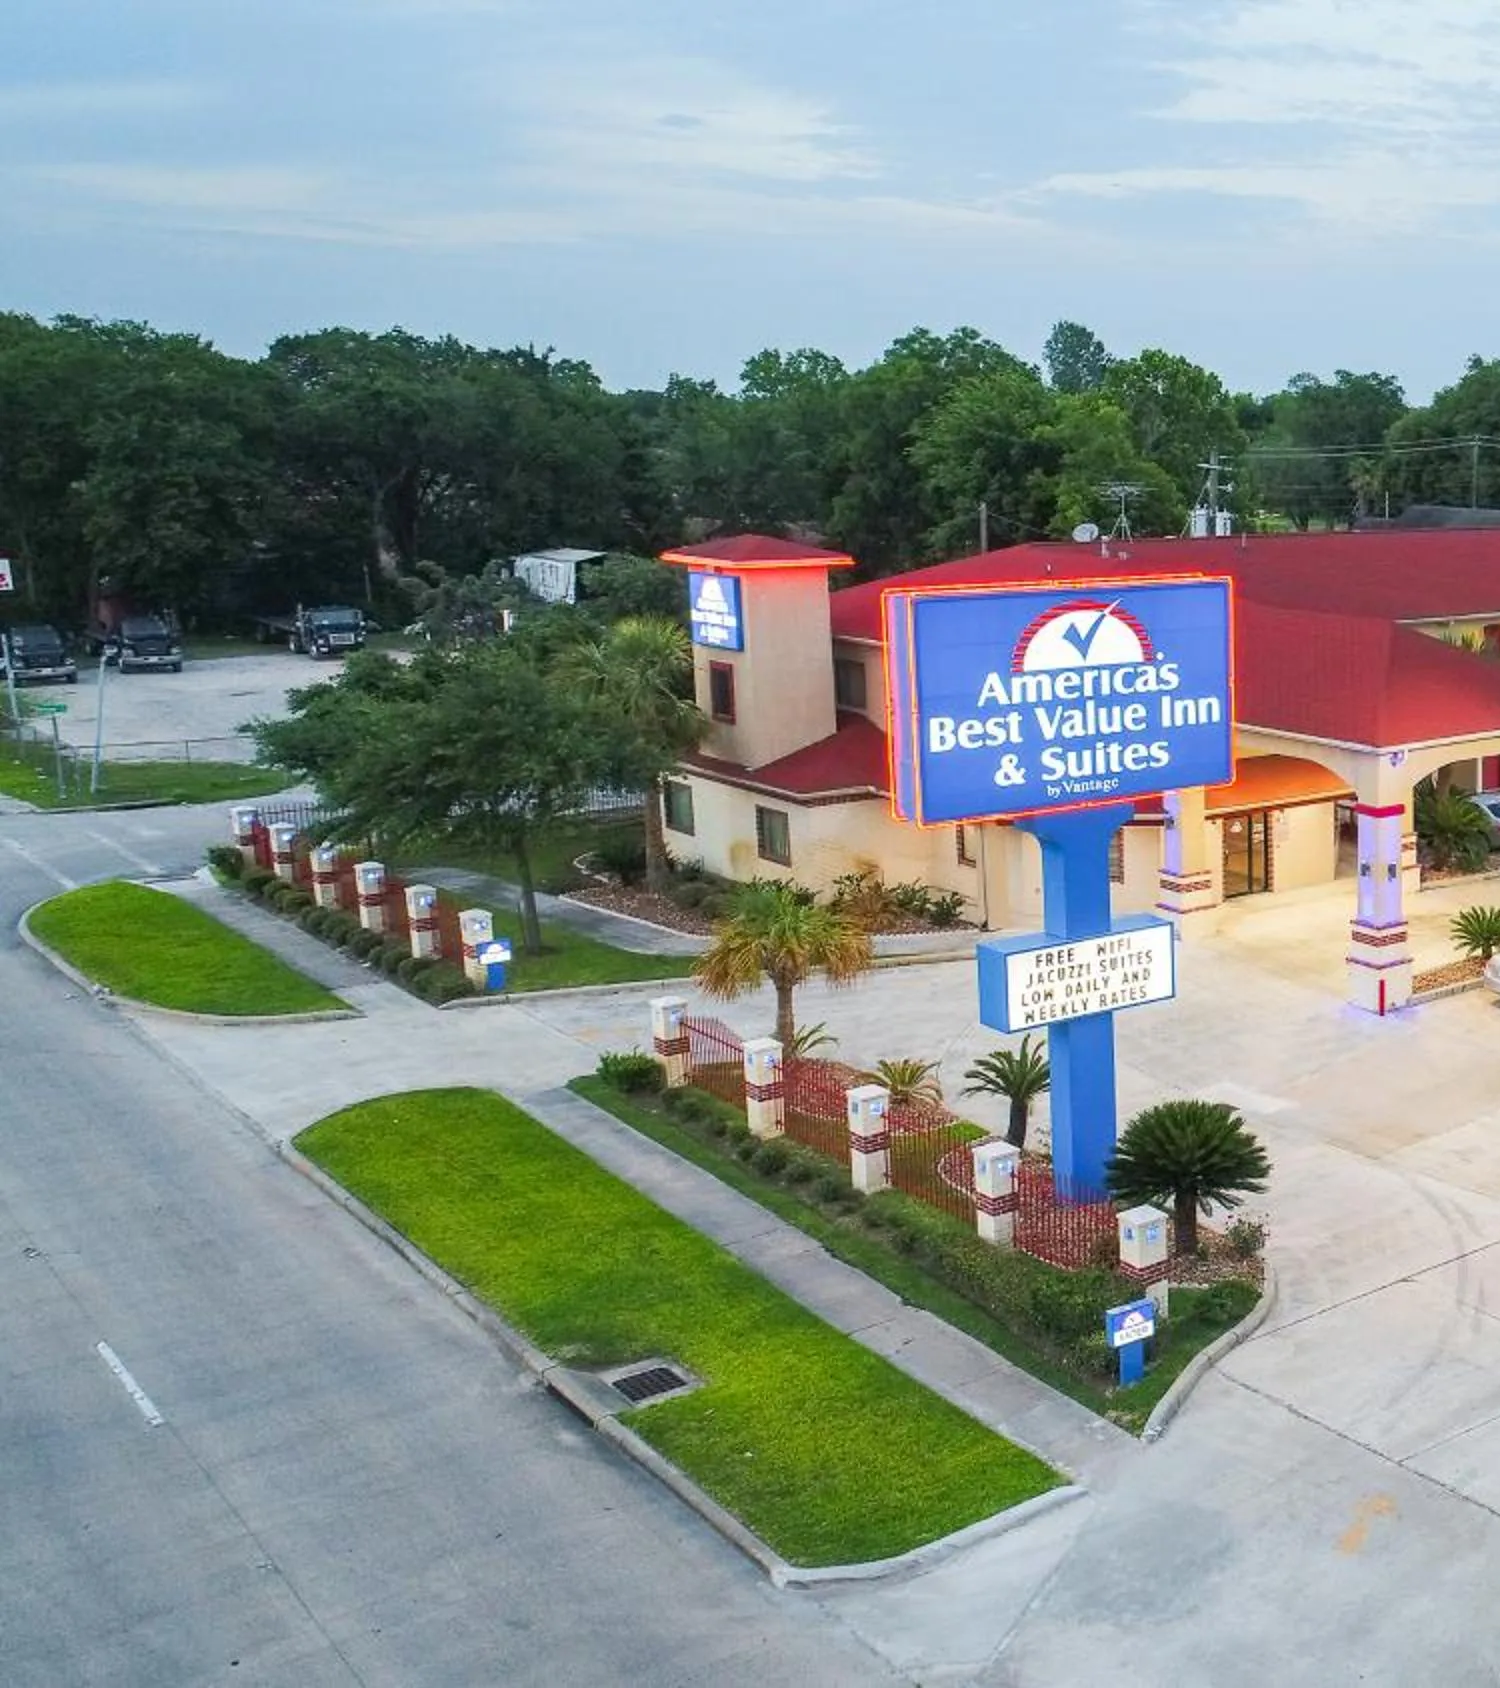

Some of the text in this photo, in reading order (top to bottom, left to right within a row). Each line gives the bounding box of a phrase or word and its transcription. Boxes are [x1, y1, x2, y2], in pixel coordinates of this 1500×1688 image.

[977, 663, 1180, 707] Americas
[929, 695, 1221, 752] Best Value Inn
[994, 741, 1170, 786] & Suites
[1046, 777, 1119, 798] by Vantage
[1025, 949, 1153, 989] JACUZZI SUITES
[1035, 948, 1075, 968] FREE
[1021, 967, 1151, 1007] LOW DAILY AND
[1024, 985, 1147, 1024] WEEKLY RATES
